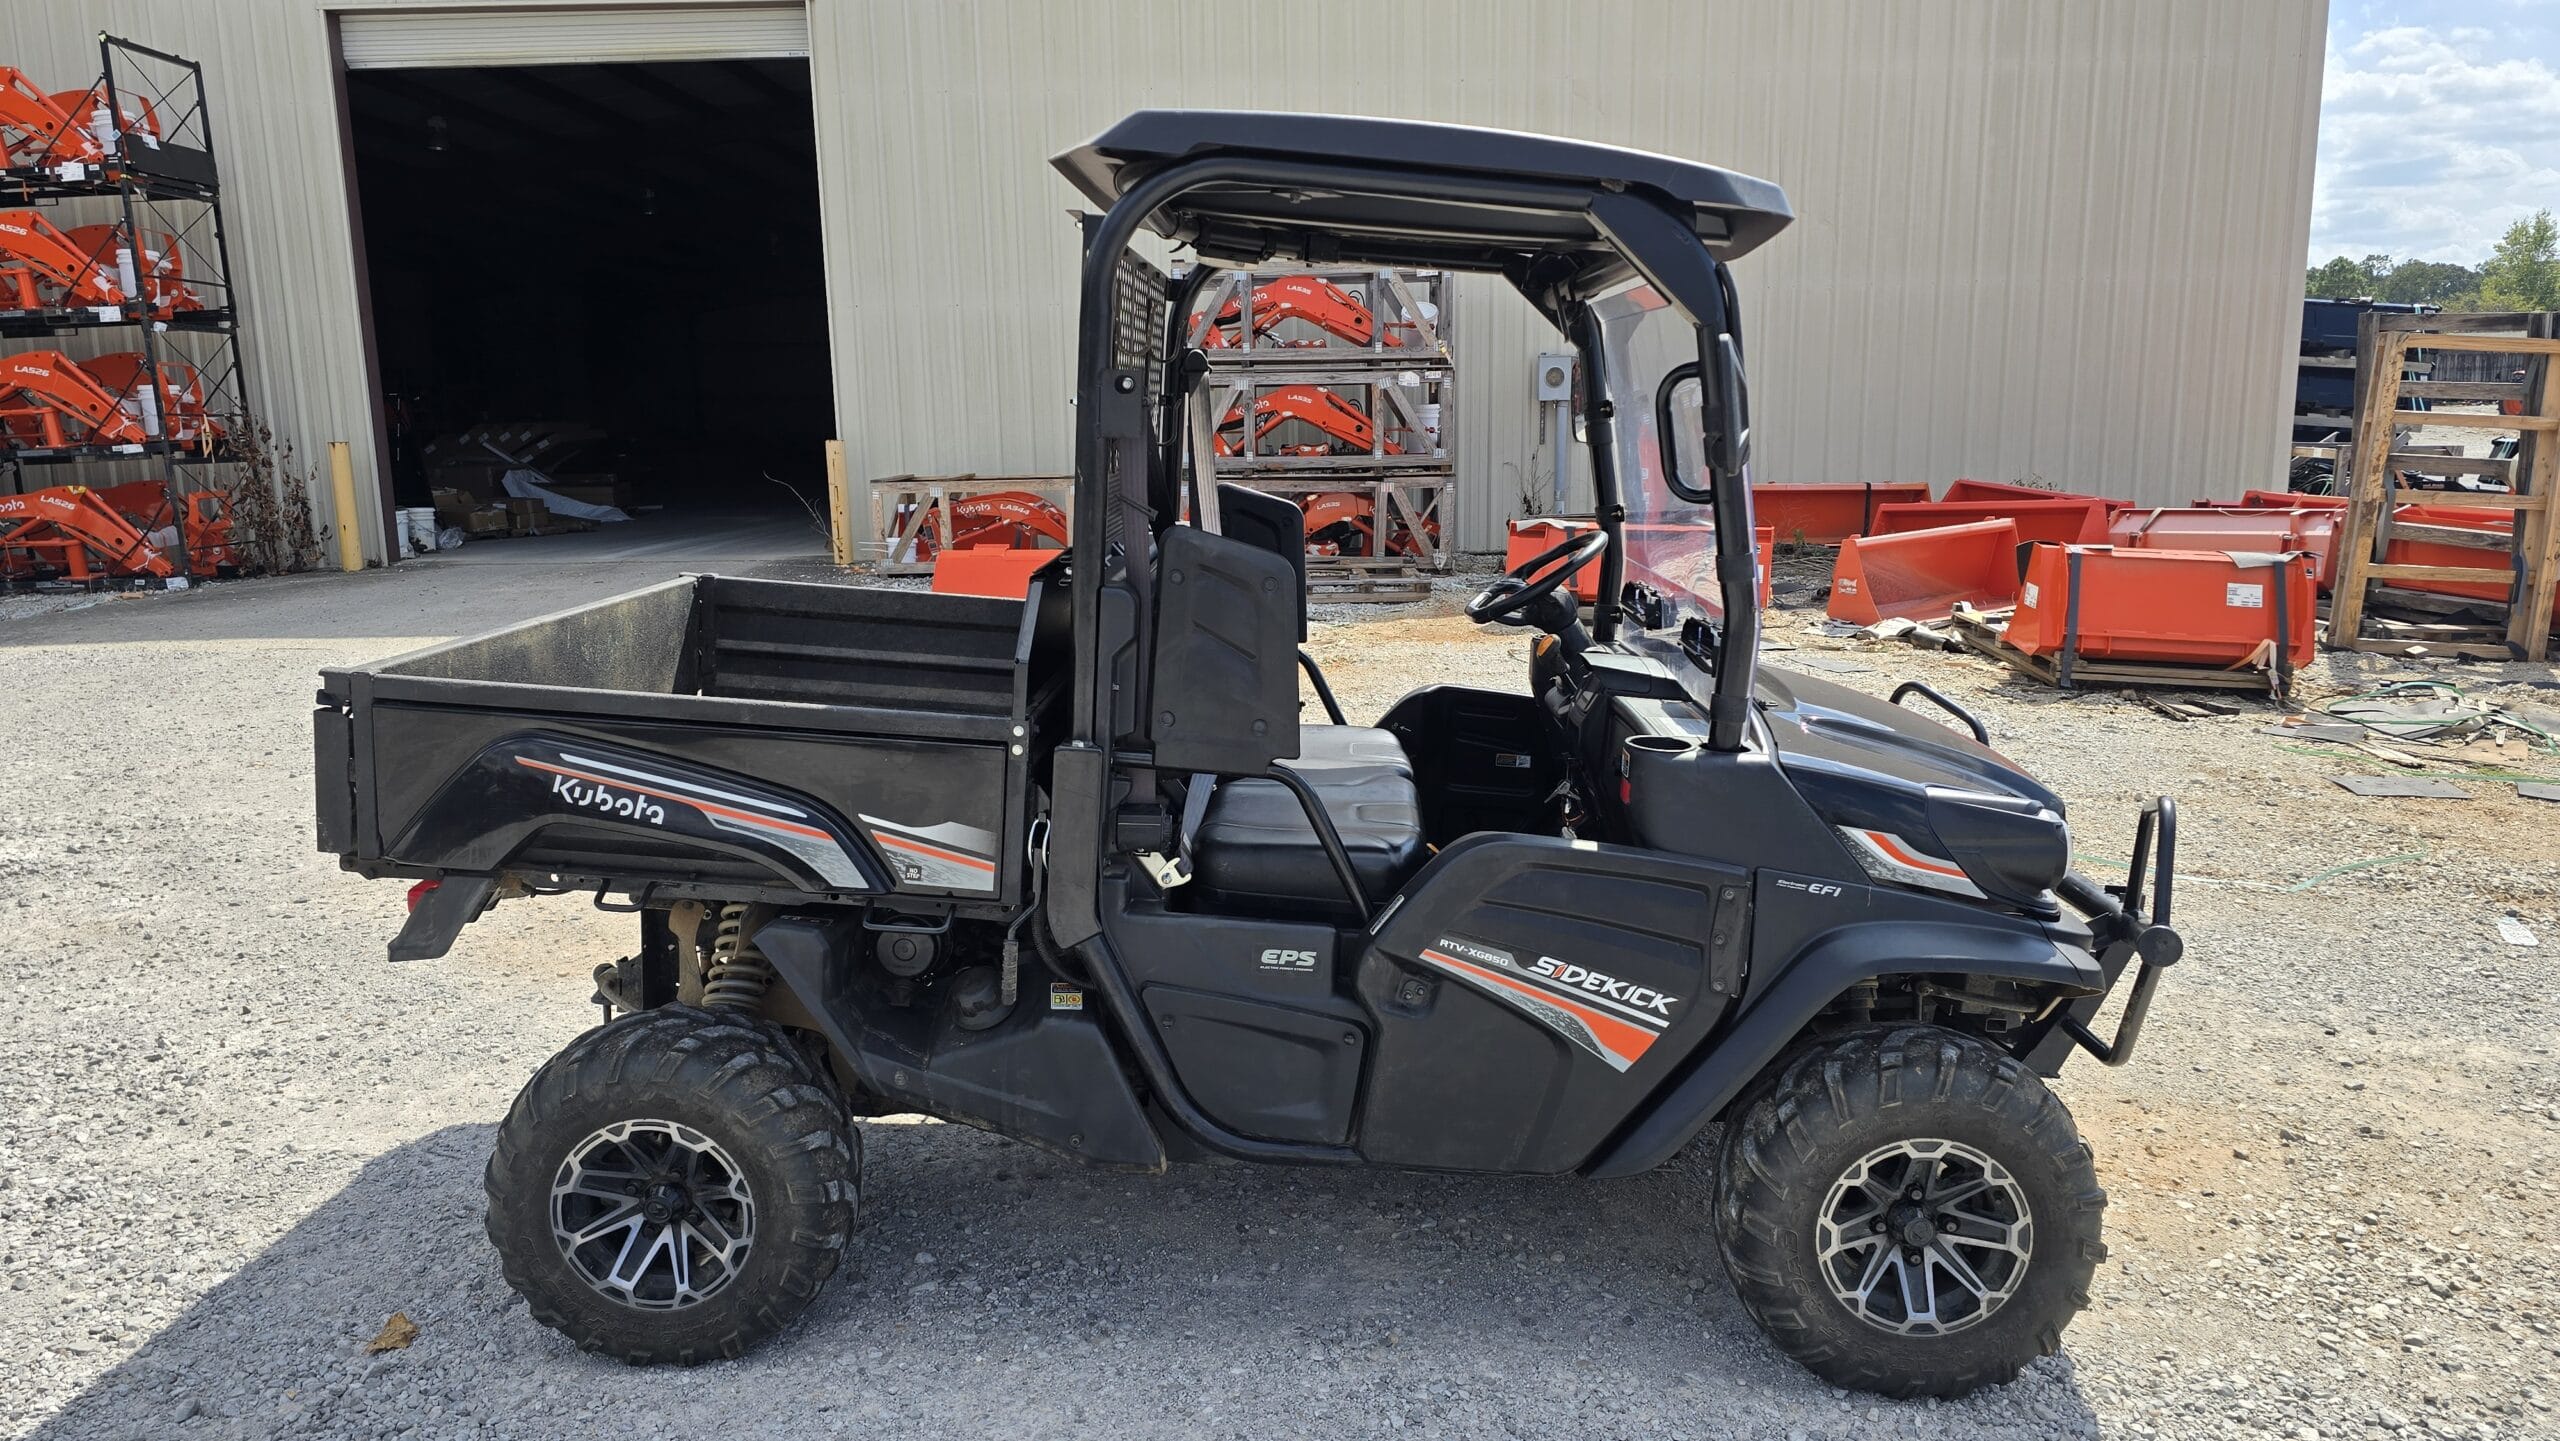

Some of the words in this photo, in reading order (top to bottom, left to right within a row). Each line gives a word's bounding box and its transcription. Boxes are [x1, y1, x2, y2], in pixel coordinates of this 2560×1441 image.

[14, 364, 50, 377] LA526
[40, 495, 76, 510] LA526
[553, 774, 665, 825] Kubota
[1808, 883, 1842, 897] EFI
[1261, 949, 1317, 966] EPS
[1439, 938, 1509, 967] RTV-XG850
[1527, 956, 1679, 1015] SIDEKICK
